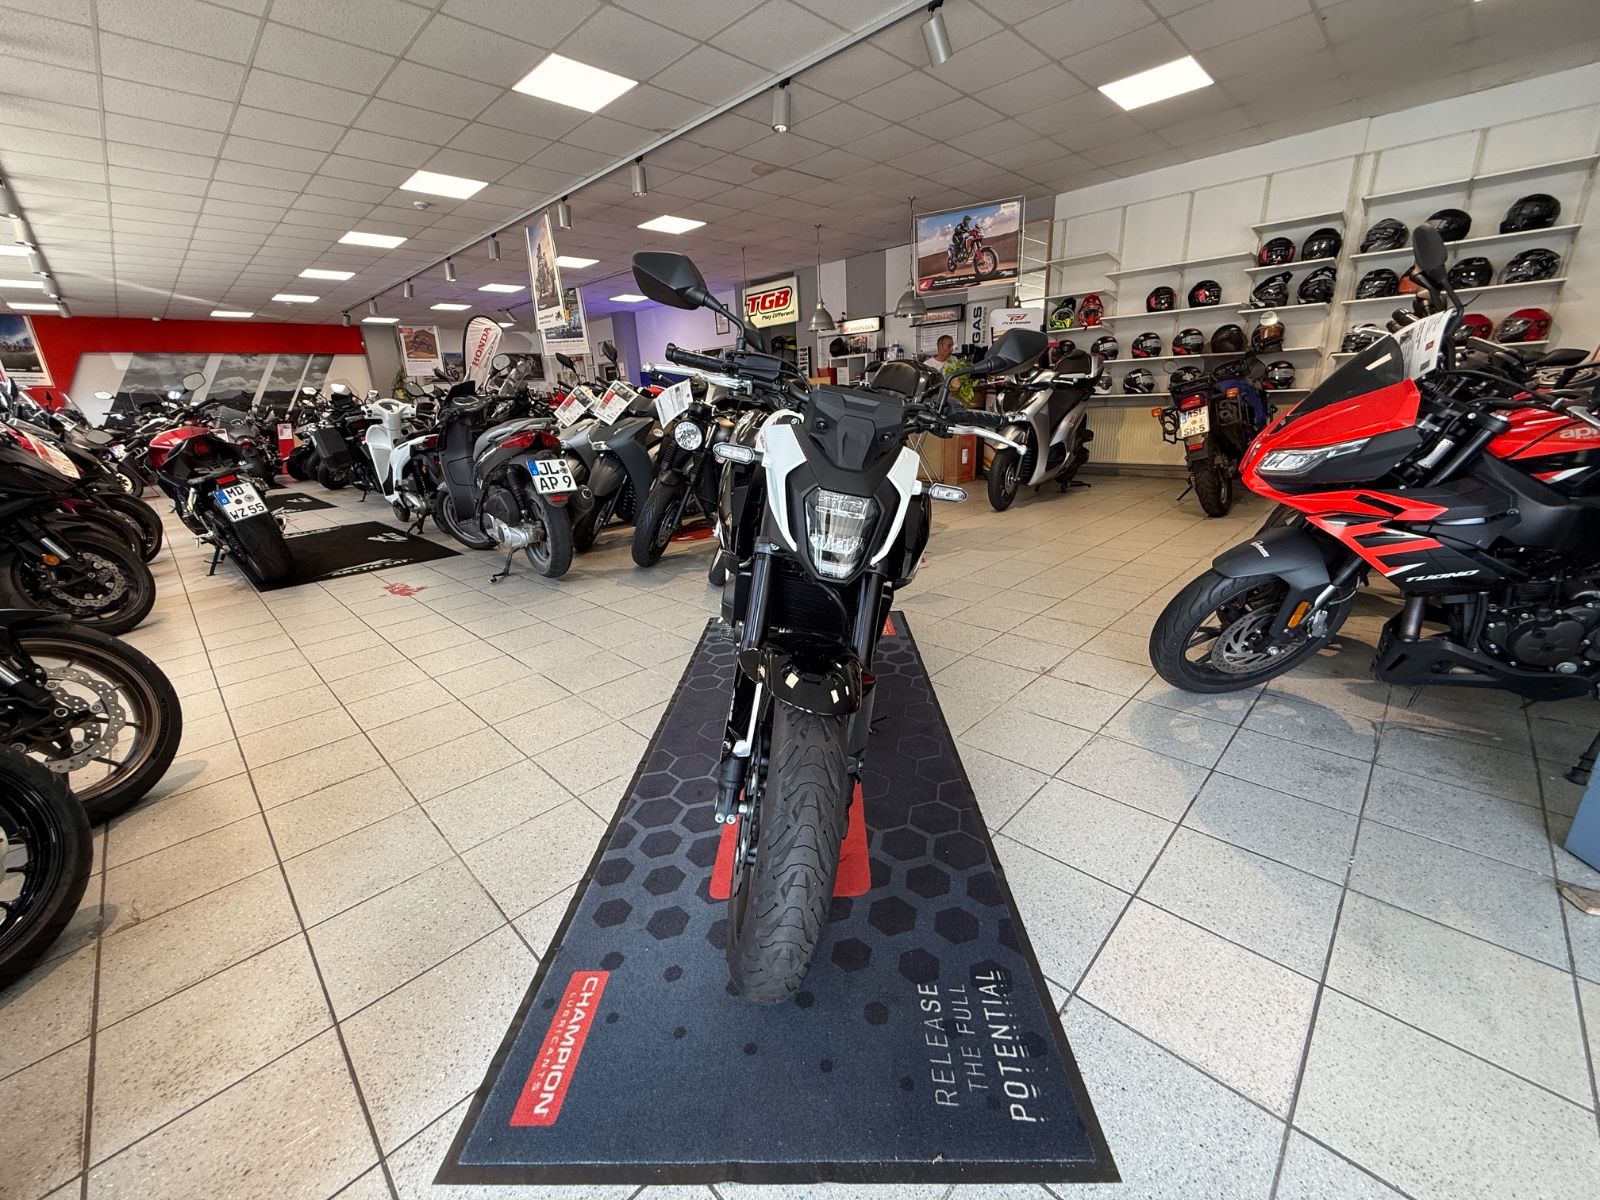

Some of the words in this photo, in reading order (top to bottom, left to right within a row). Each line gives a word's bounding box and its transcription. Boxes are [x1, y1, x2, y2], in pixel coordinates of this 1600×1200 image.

[747, 289, 790, 314] TGB
[773, 310, 795, 319] Different
[972, 306, 982, 343] GAS
[472, 326, 491, 367] HONDA
[539, 462, 560, 475] JL
[540, 477, 559, 491] AP
[562, 475, 572, 488] 9
[225, 486, 245, 498] MD
[230, 508, 248, 520] WZ
[248, 502, 265, 514] 55
[1405, 569, 1480, 582] TUONO
[948, 984, 976, 1035] FULL
[531, 992, 577, 1092] LUBRICANTS
[533, 976, 599, 1118] CHAMPION
[917, 983, 960, 1107] RELEASE
[975, 970, 1037, 1123] POTENTIAL
[961, 1046, 988, 1092] THE
